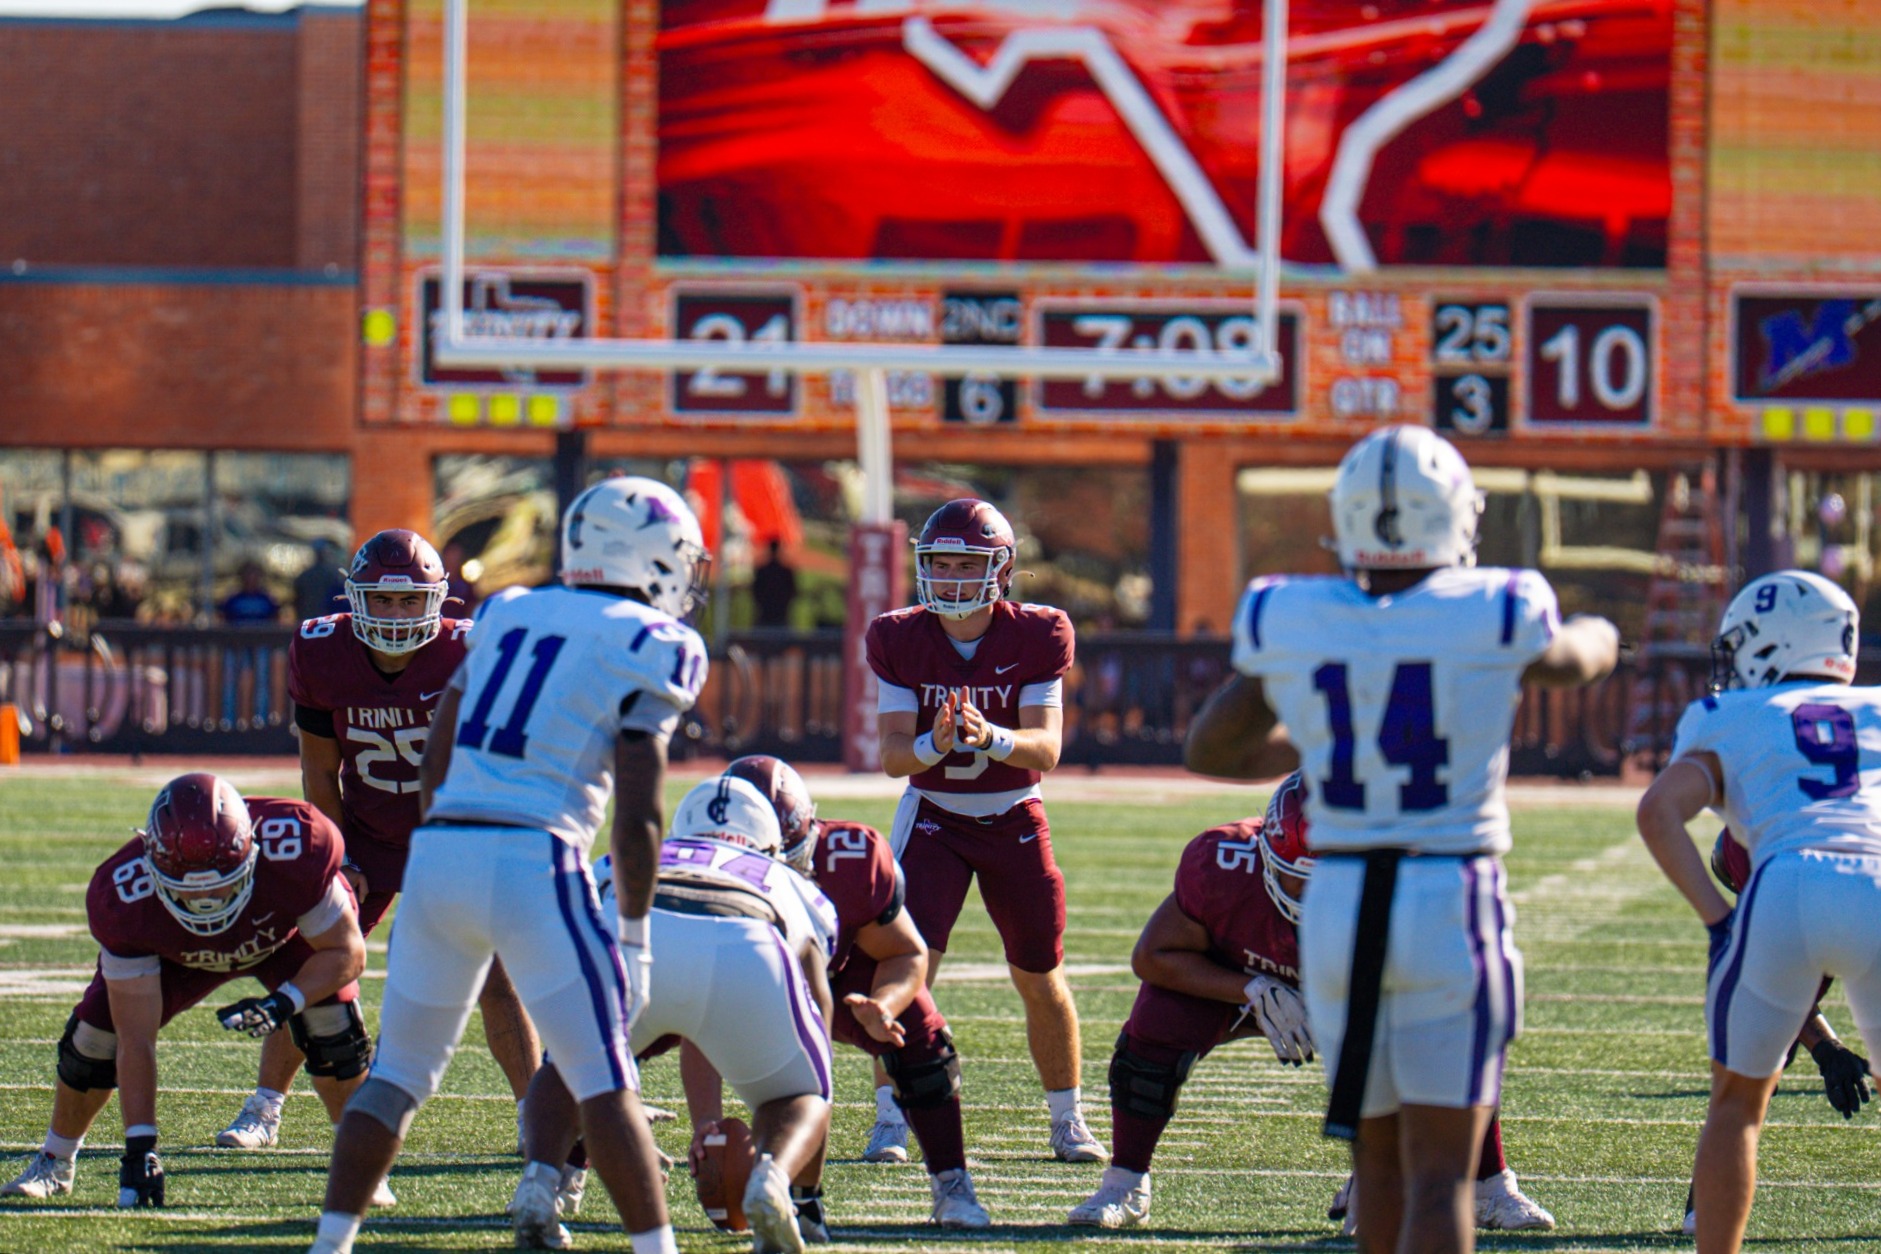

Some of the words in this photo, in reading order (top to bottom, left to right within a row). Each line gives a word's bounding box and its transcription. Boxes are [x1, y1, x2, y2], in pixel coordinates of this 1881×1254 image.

[690, 313, 790, 396] 21
[1435, 304, 1510, 362] 25
[959, 367, 1003, 425] 6
[1540, 324, 1648, 410] 10
[1451, 373, 1494, 436] 3
[1754, 583, 1779, 615] 9
[457, 626, 568, 760] 11
[1311, 661, 1450, 813] 14
[1791, 702, 1862, 801] 9
[261, 817, 303, 862] 69
[827, 830, 867, 873] 72
[112, 857, 156, 904] 69
